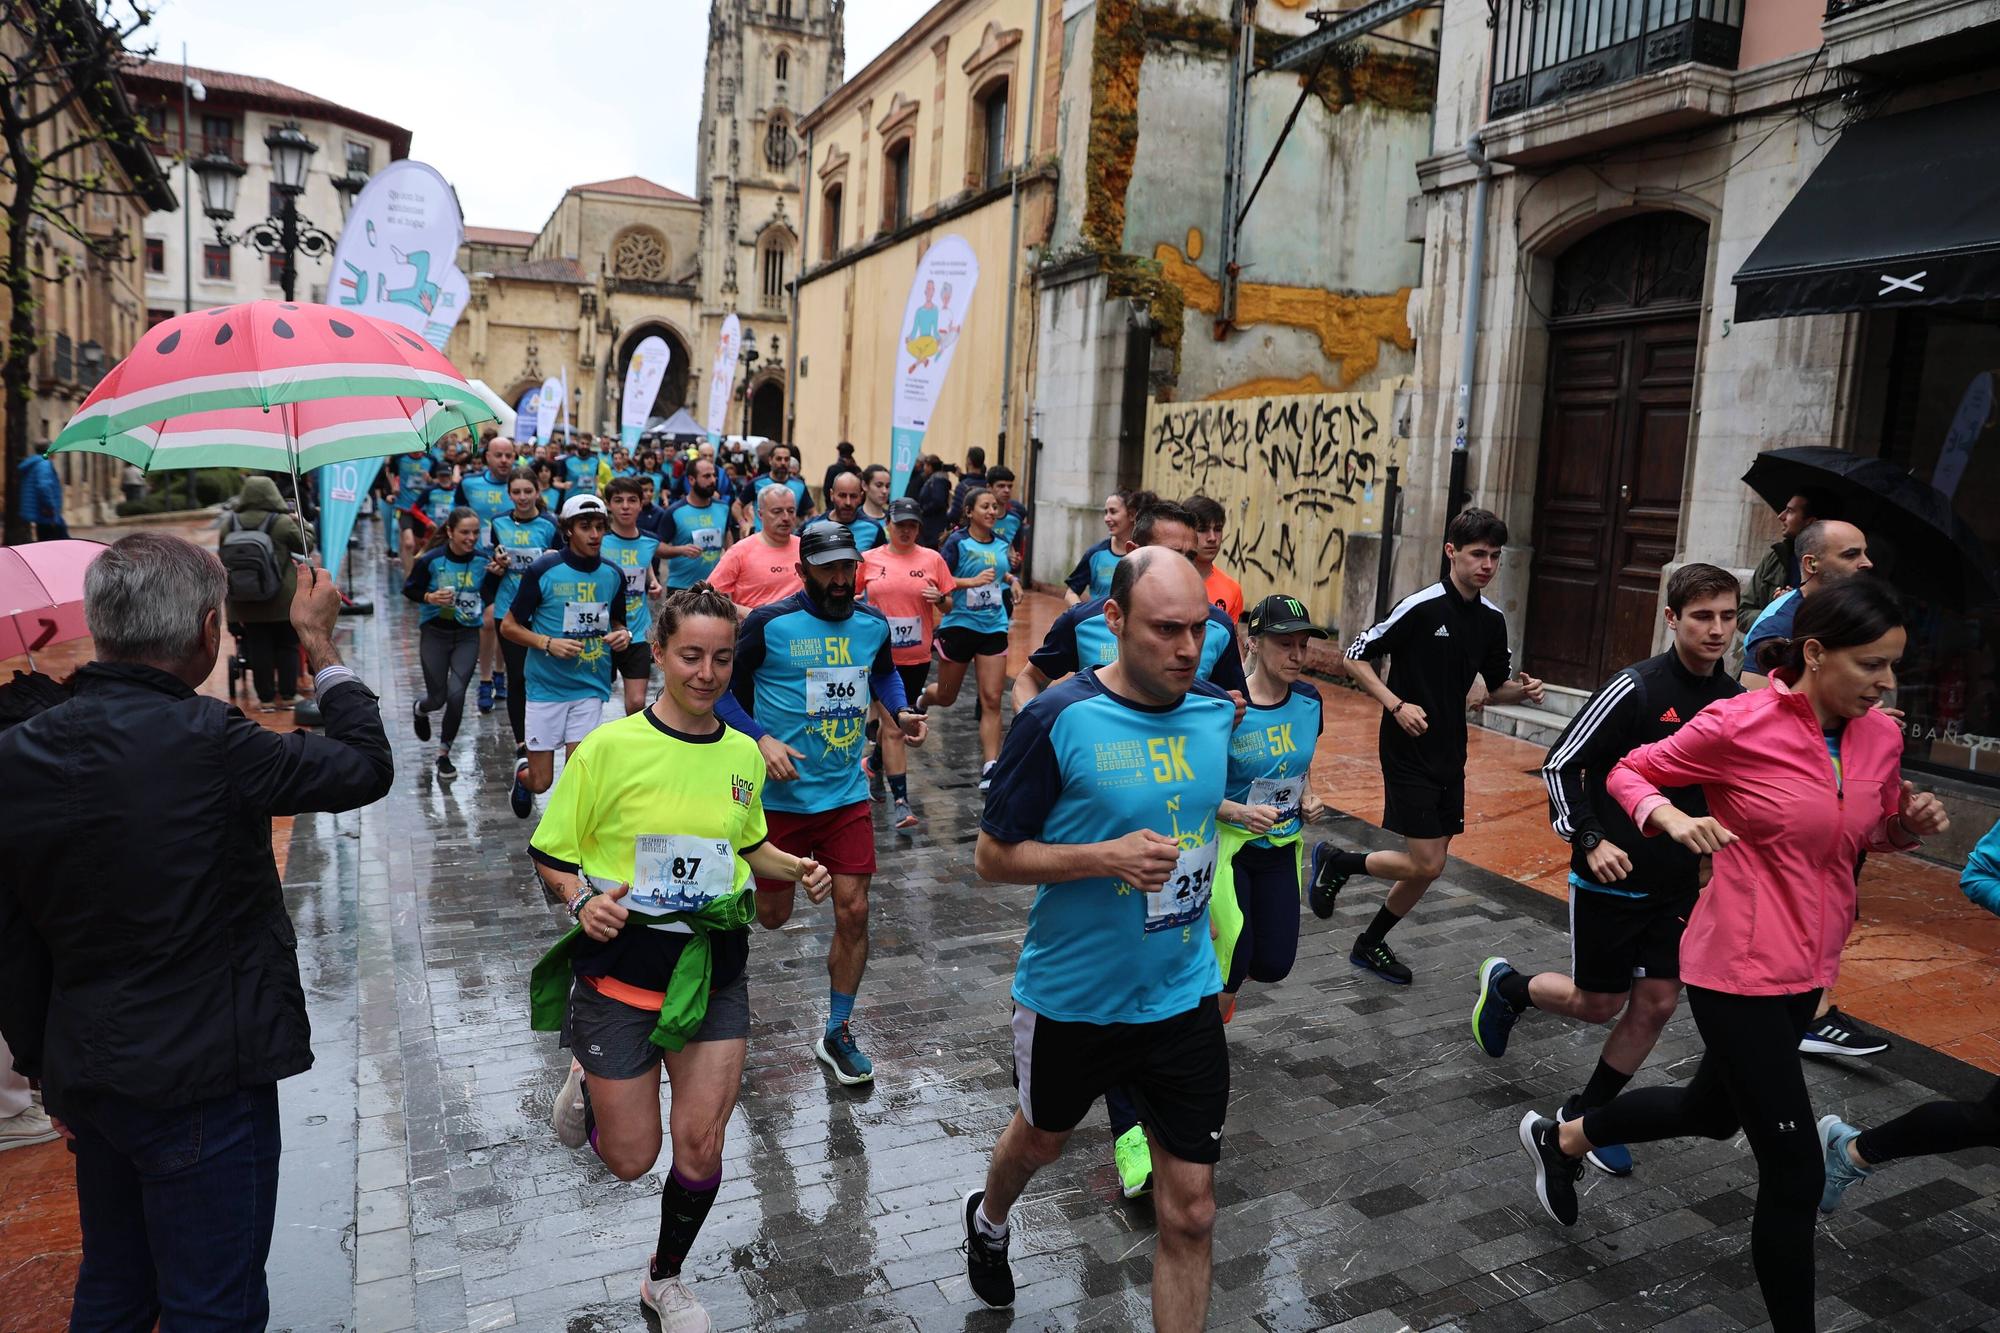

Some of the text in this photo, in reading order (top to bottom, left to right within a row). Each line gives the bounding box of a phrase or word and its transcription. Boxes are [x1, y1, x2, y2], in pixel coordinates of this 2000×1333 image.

[513, 530, 531, 545] 5K
[621, 549, 638, 566] 5K
[457, 571, 475, 588] 5K
[577, 581, 597, 603] 5K
[980, 590, 991, 599] 93
[578, 612, 600, 624] 354
[895, 625, 913, 636] 197
[825, 636, 852, 665] 5K
[826, 682, 856, 699] 366
[1267, 722, 1297, 757] 5K
[1096, 757, 1147, 772] SEGURIDAD
[1147, 736, 1196, 783] 5K
[731, 774, 754, 791] Llano
[1166, 794, 1181, 815] N
[1275, 789, 1291, 803] 12
[716, 843, 728, 856] 5K
[672, 857, 702, 880] 87
[1175, 861, 1212, 900] 234
